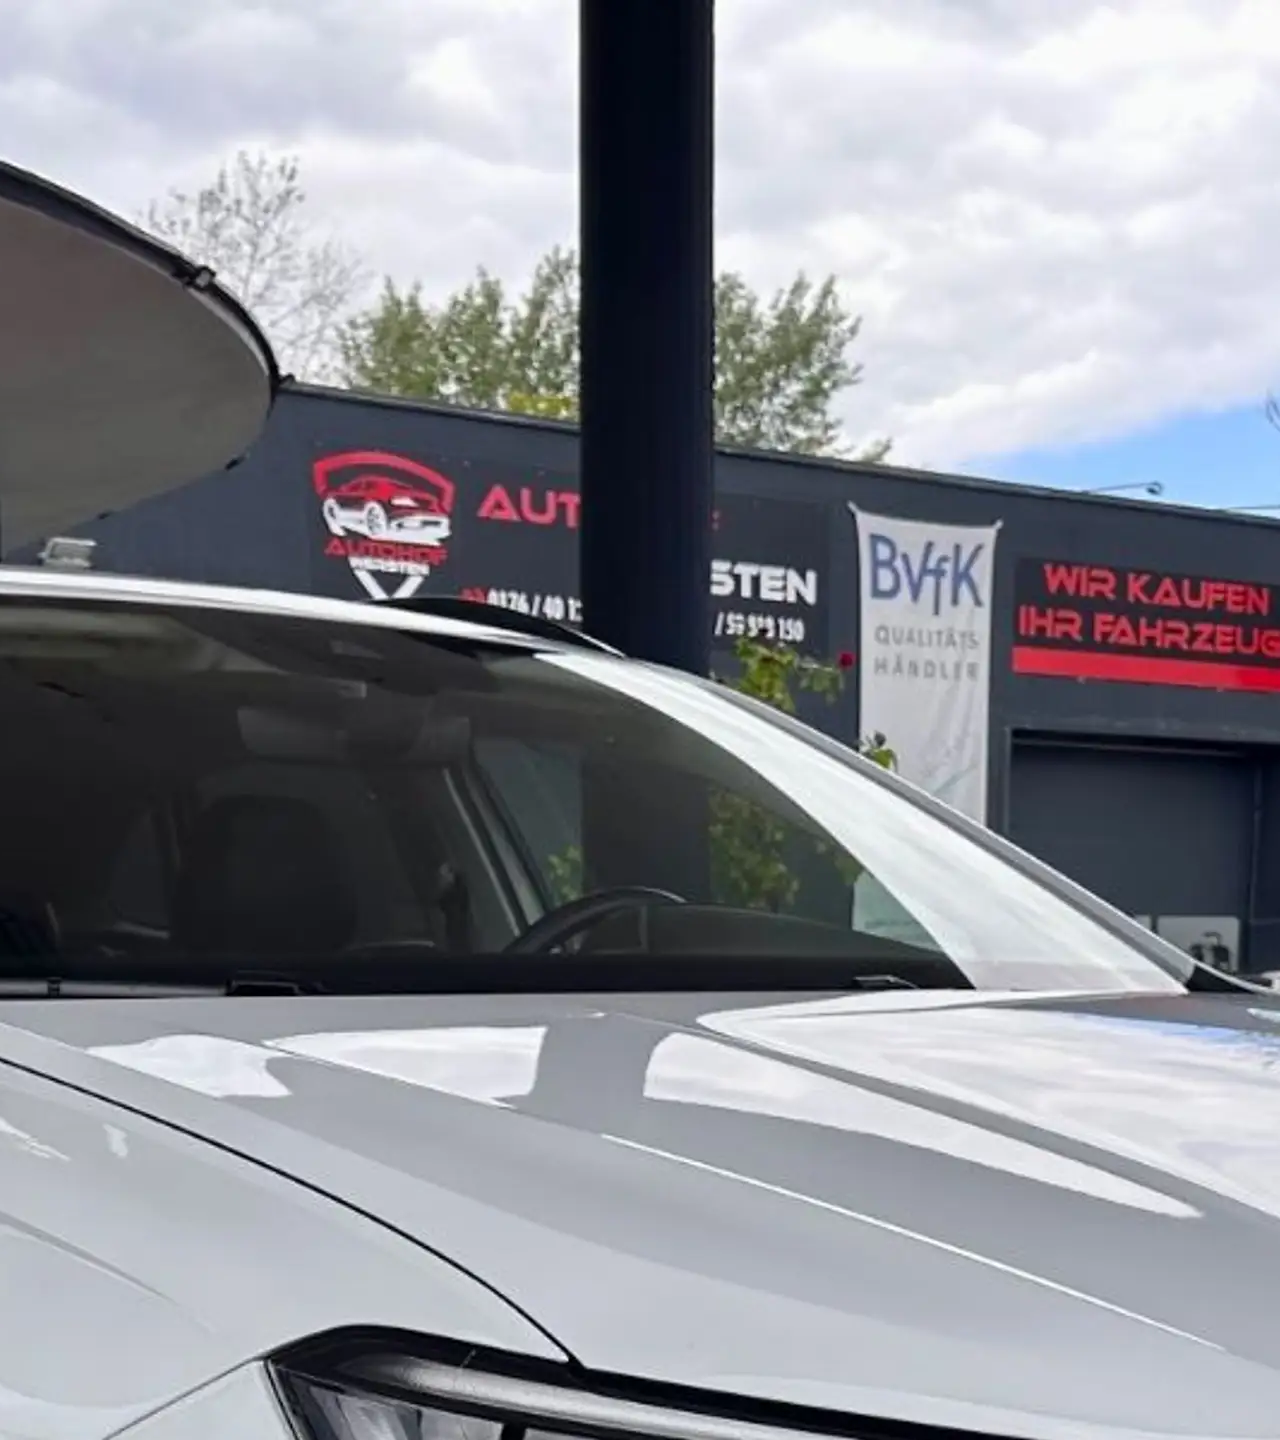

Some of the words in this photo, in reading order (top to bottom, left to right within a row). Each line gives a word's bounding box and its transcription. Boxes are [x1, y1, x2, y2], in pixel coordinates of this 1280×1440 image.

[709, 559, 817, 605] STEN
[1044, 563, 1117, 600] WIR
[1127, 572, 1271, 617] KAUFEN
[1019, 604, 1083, 642] IHR
